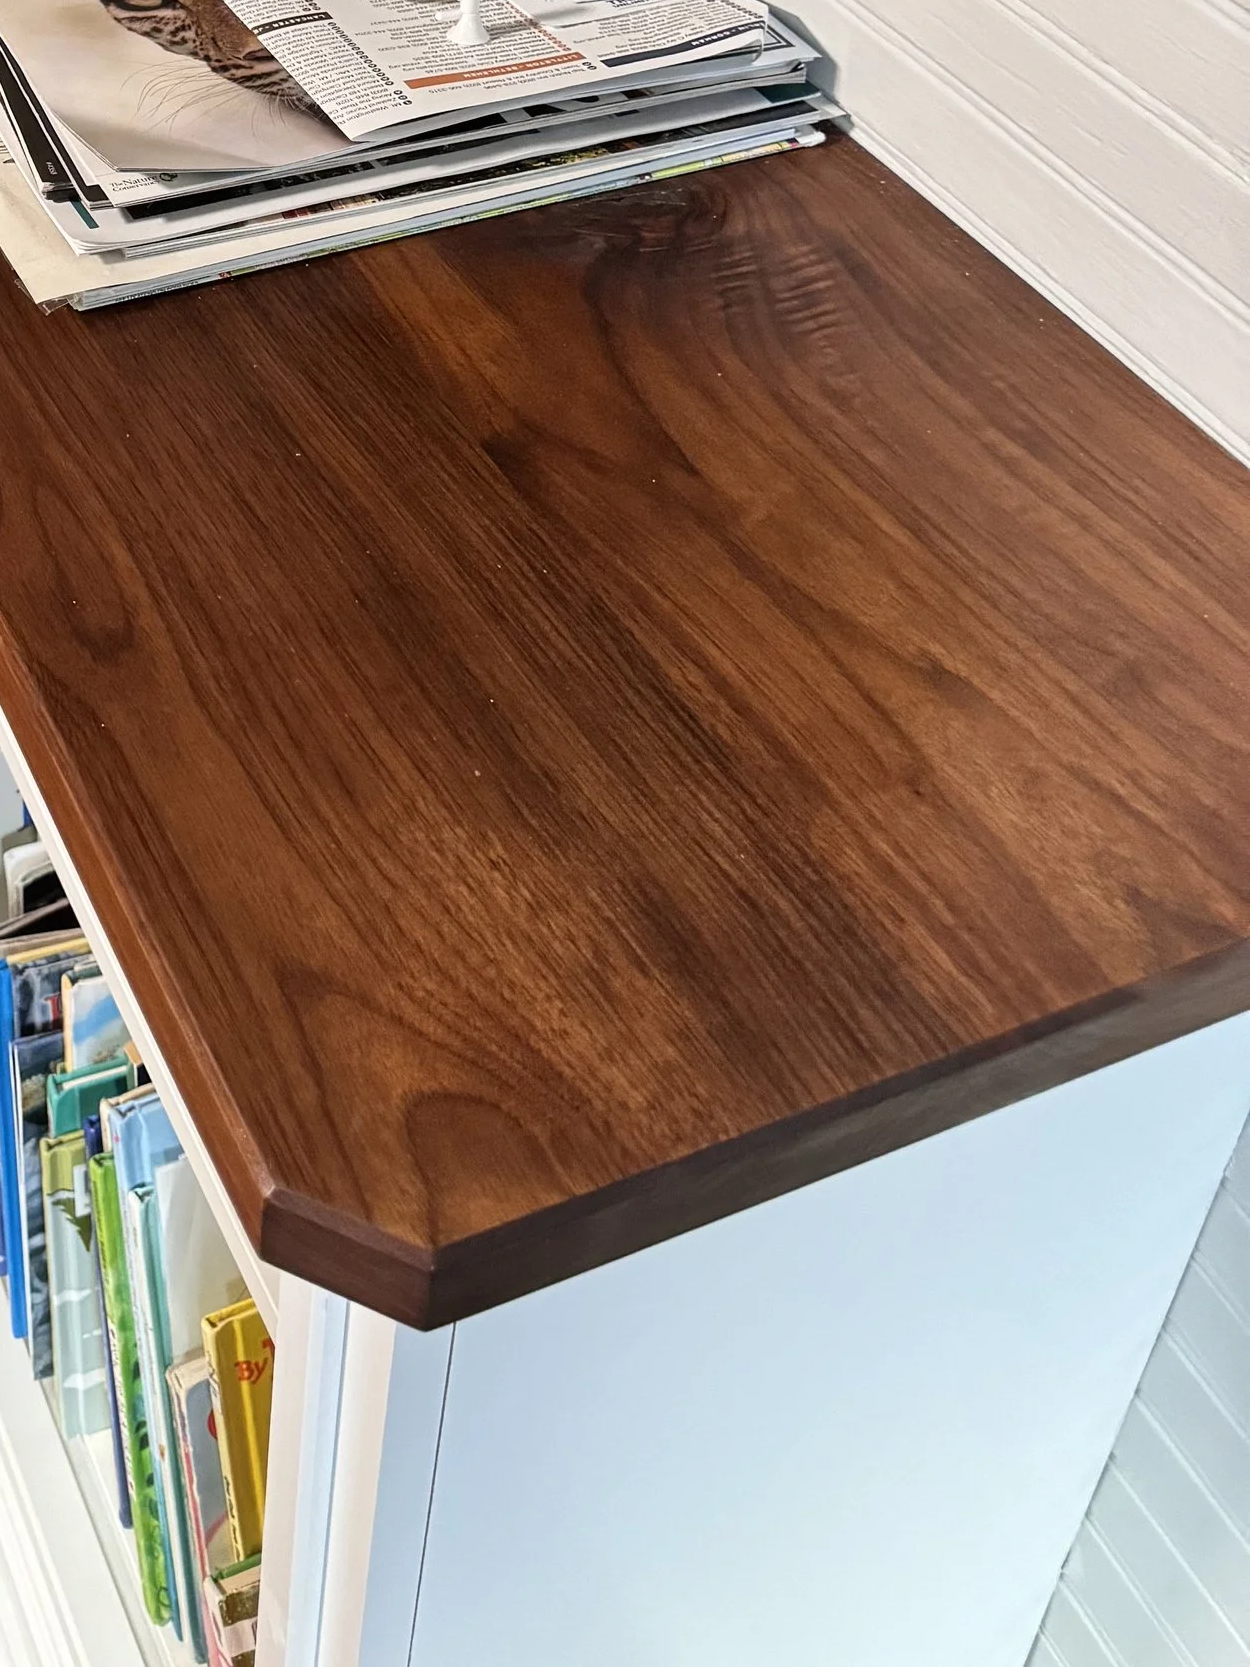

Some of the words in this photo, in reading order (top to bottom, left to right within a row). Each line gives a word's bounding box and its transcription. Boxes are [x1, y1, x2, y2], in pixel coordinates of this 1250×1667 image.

[271, 13, 326, 28] LANCASTER
[688, 30, 732, 45] GORHAM
[522, 54, 578, 67] LITTLETON
[461, 65, 519, 78] BETHLEHEM
[122, 175, 160, 187] Nature
[234, 1357, 269, 1386] By
